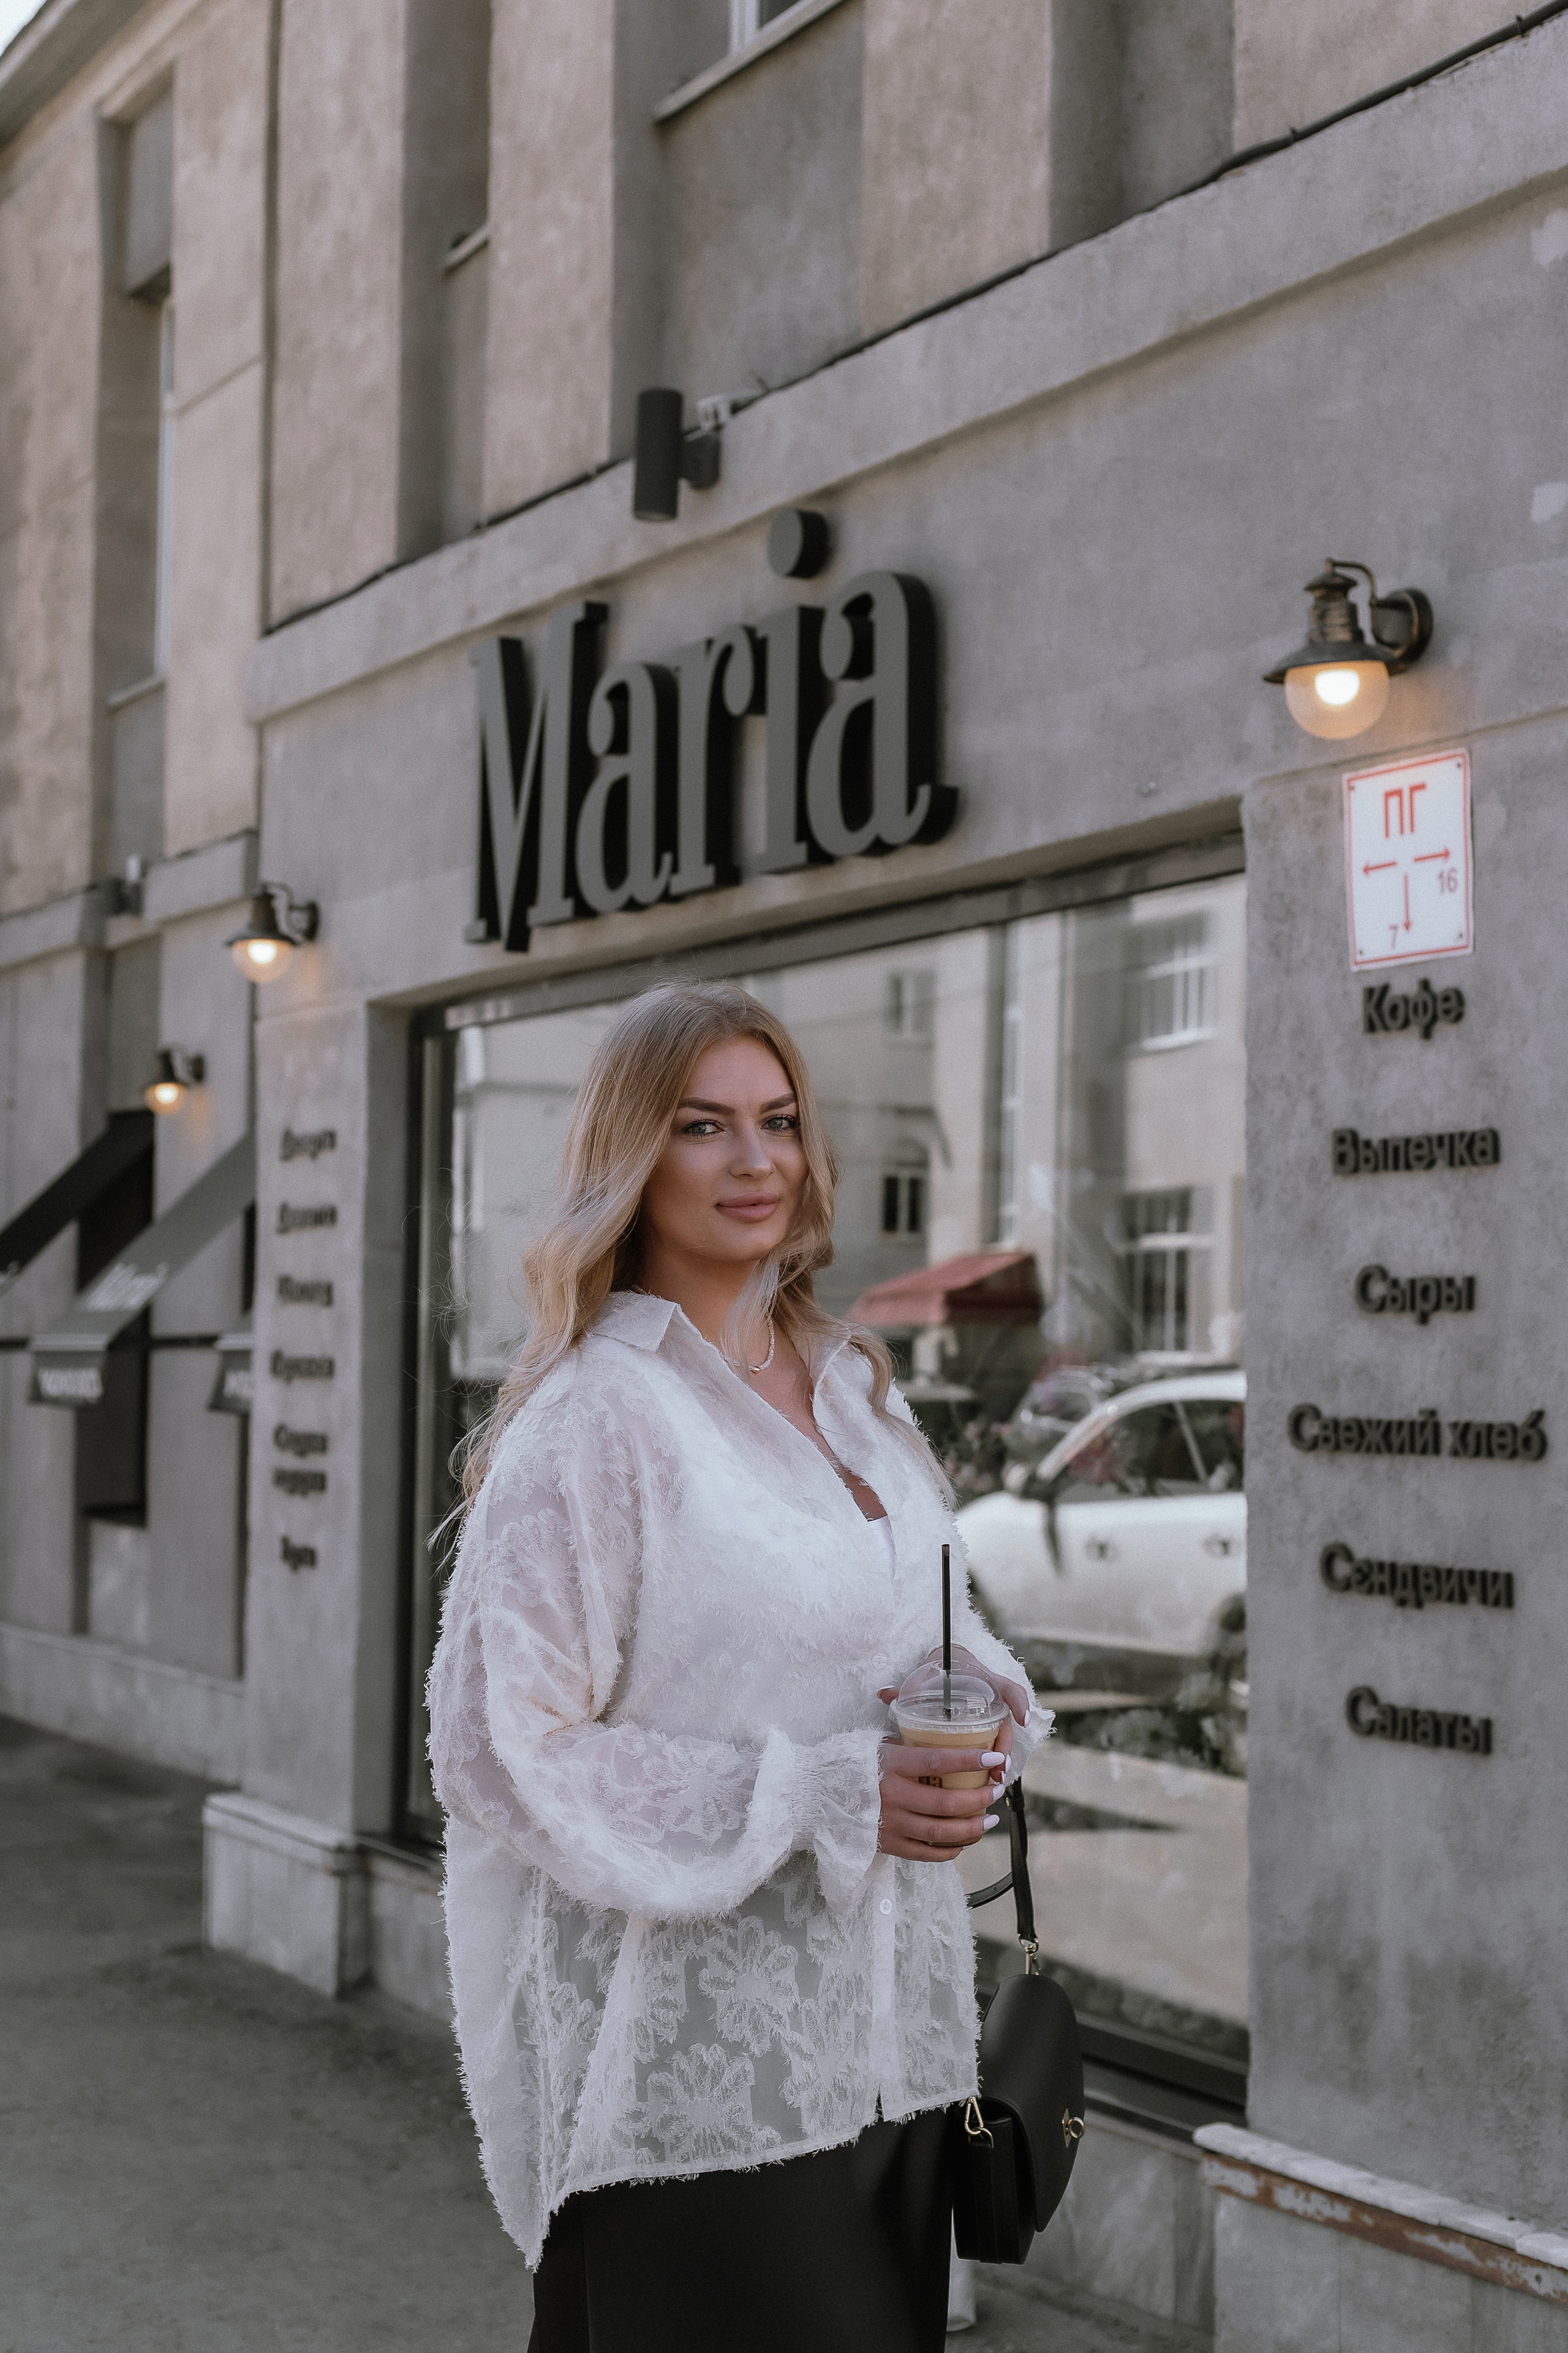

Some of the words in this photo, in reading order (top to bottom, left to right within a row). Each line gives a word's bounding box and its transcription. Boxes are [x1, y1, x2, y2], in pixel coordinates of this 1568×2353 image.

[464, 507, 960, 952] Maria
[1384, 782, 1427, 839] ПГ
[1438, 868, 1458, 894] 16
[1388, 924, 1400, 949] 7
[1363, 978, 1465, 1040] Кофе
[1332, 1128, 1501, 1176] Выпечка
[1355, 1264, 1477, 1325] Сыры
[1288, 1403, 1441, 1457] Свежий
[1449, 1408, 1548, 1462] хлеб
[1320, 1541, 1515, 1610] Сэндвичи
[1346, 1685, 1493, 1756] Салаты
